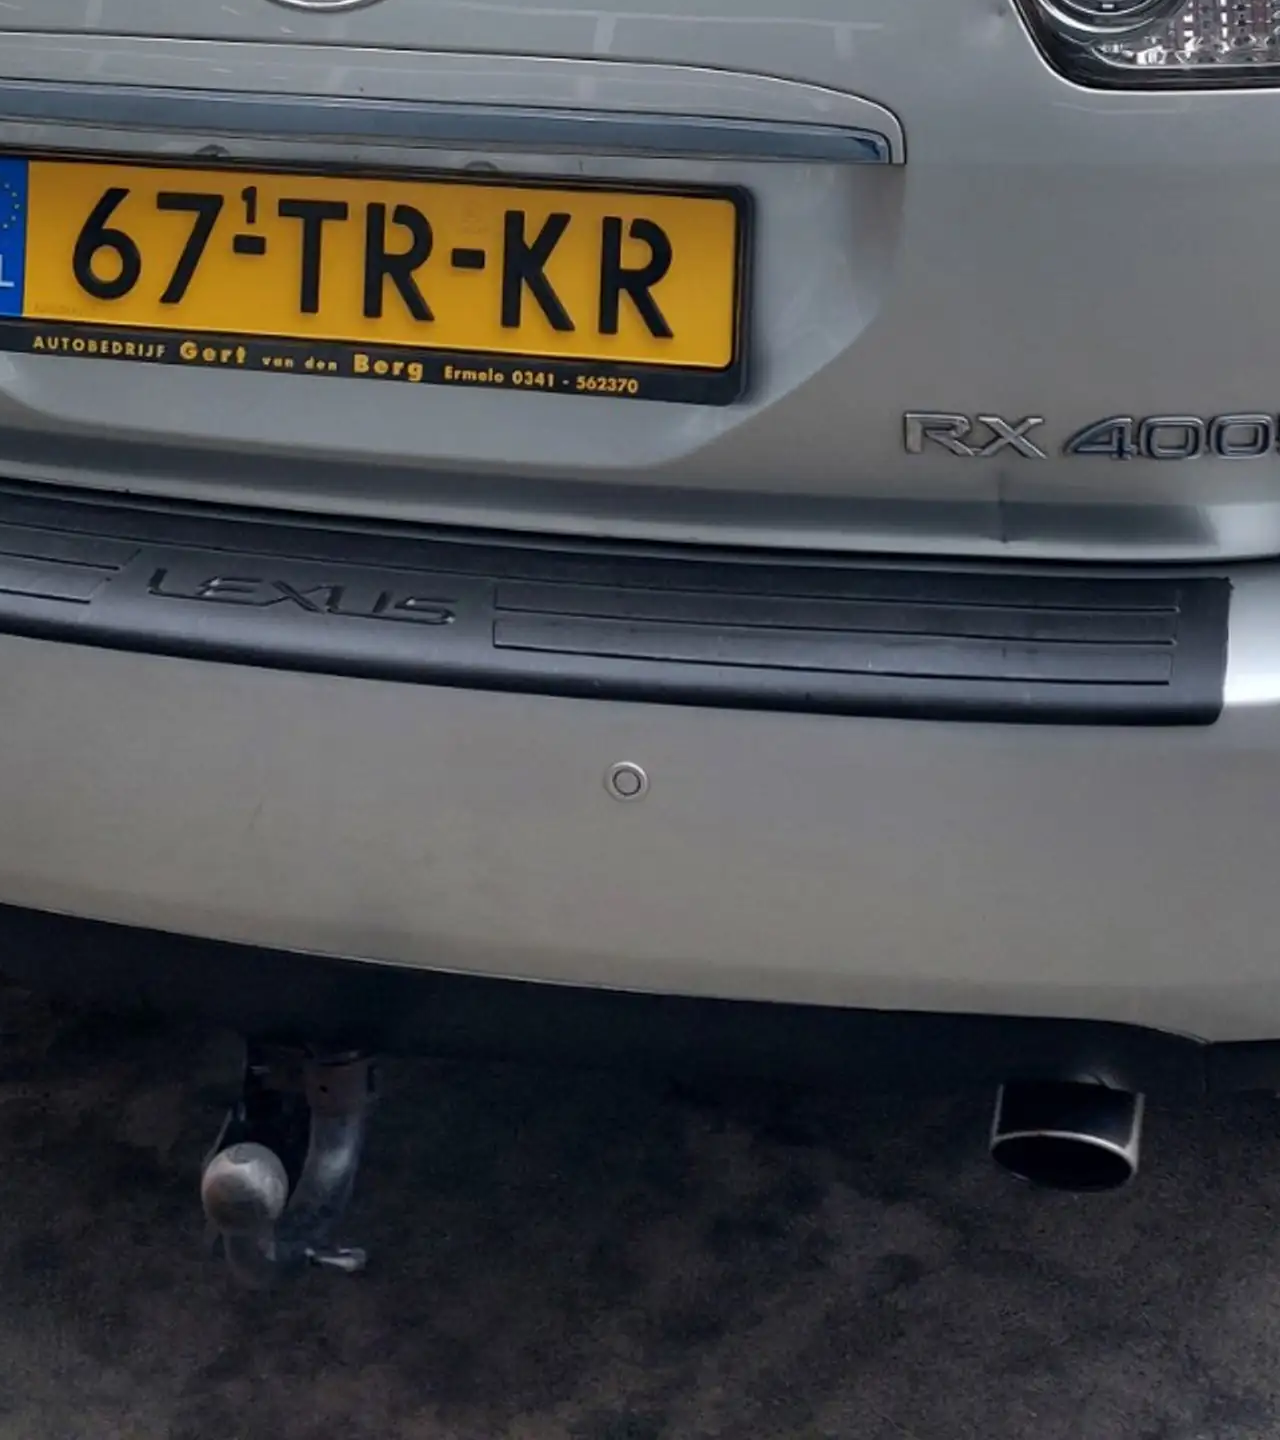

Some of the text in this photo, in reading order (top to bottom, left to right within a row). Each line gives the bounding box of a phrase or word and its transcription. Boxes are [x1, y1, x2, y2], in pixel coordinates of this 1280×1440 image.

[32, 335, 166, 358] AUTOBEDRIJF
[179, 341, 247, 364] Gert
[262, 355, 294, 369] van
[511, 369, 555, 387] 0341
[575, 375, 639, 394] 562370
[903, 411, 1048, 459] RX
[147, 568, 458, 626] LEXUS
